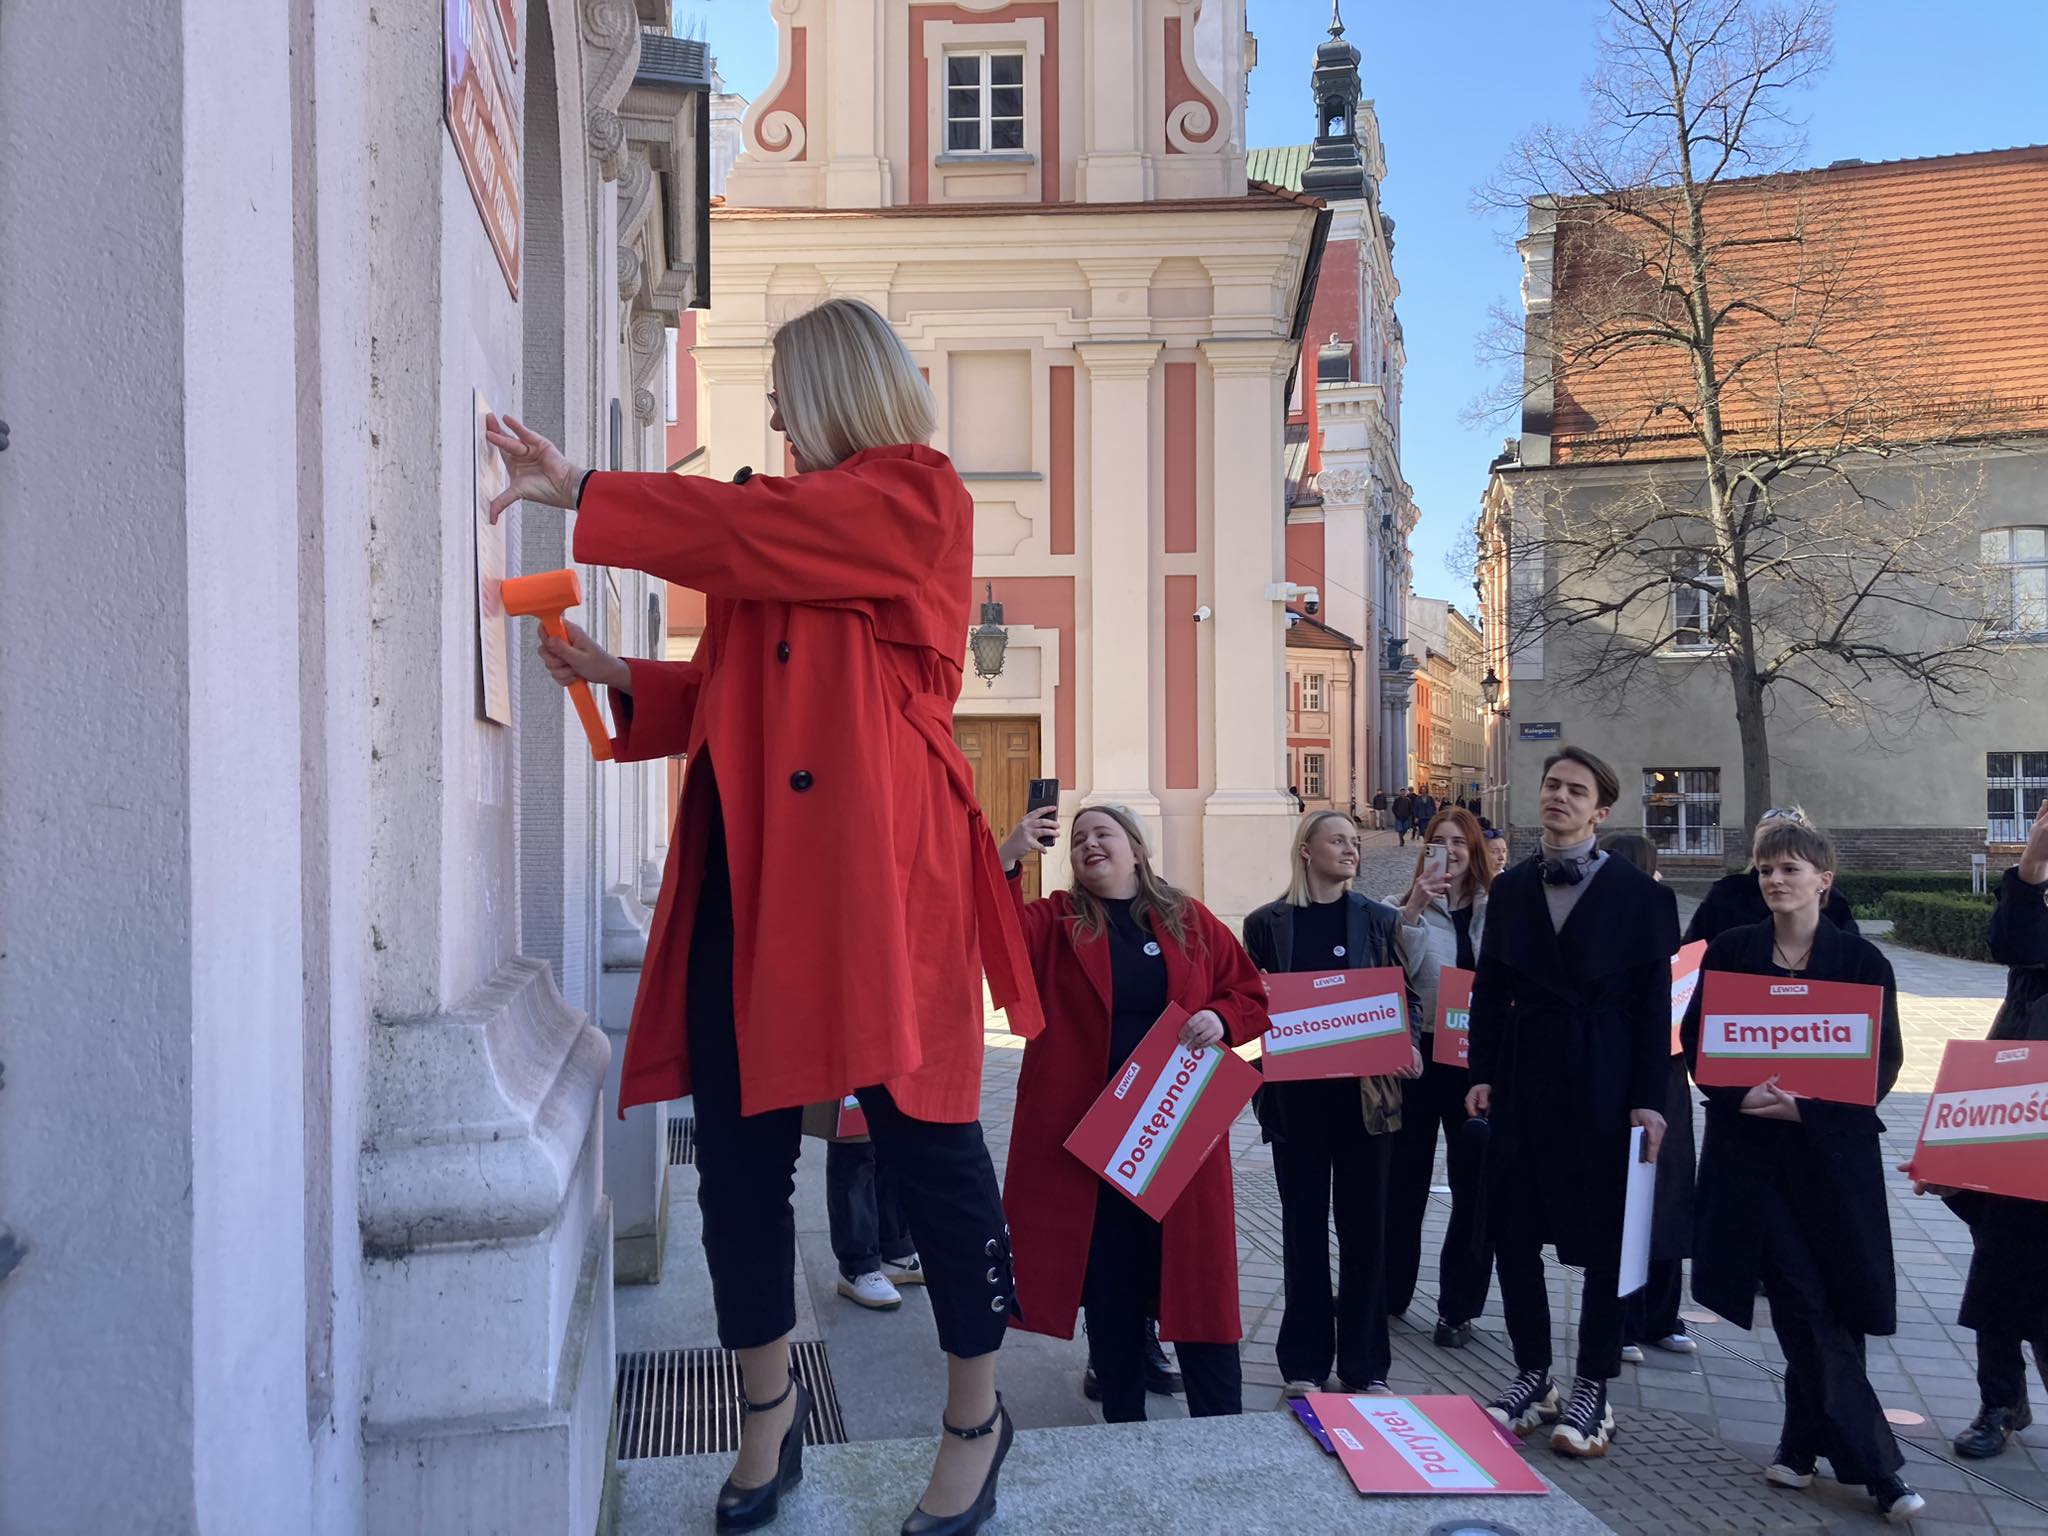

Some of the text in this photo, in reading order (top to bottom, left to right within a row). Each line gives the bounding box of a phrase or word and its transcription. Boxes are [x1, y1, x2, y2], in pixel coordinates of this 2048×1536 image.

[1315, 976, 1344, 987] LEWICA
[1772, 985, 1806, 993] LEWICA
[1270, 1005, 1397, 1040] Dostosowanie
[1723, 1019, 1852, 1050] Empatia
[1116, 1064, 1139, 1097] LEWICA
[1117, 1046, 1205, 1180] Dostępność
[1370, 1410, 1459, 1474] Parytet
